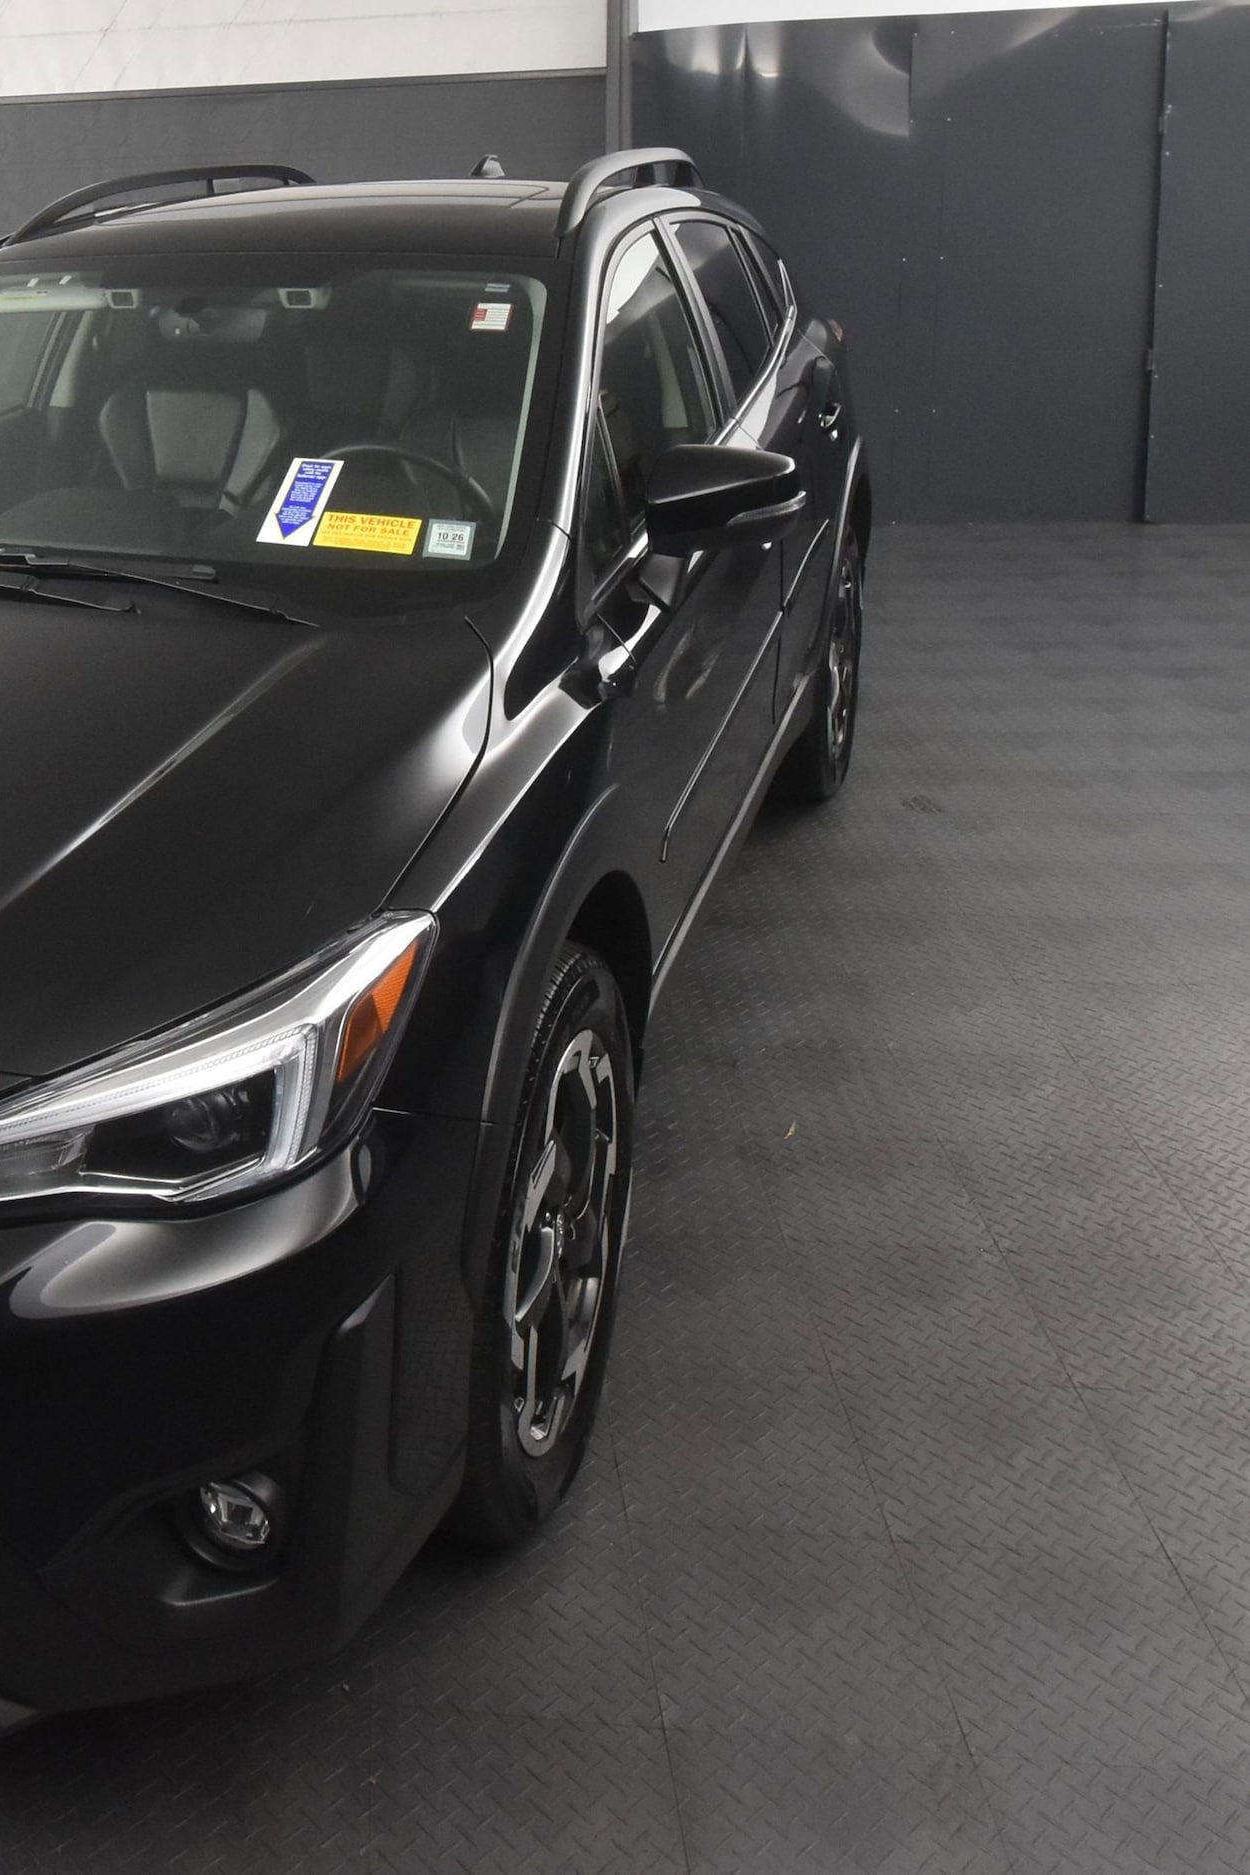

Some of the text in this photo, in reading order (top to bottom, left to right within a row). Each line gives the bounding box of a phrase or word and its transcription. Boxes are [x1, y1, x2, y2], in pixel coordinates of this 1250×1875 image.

[328, 514, 416, 529] THIS VEHICLE
[353, 524, 377, 533] FOR
[381, 527, 411, 537] SALE
[438, 532, 464, 541] 10 26
